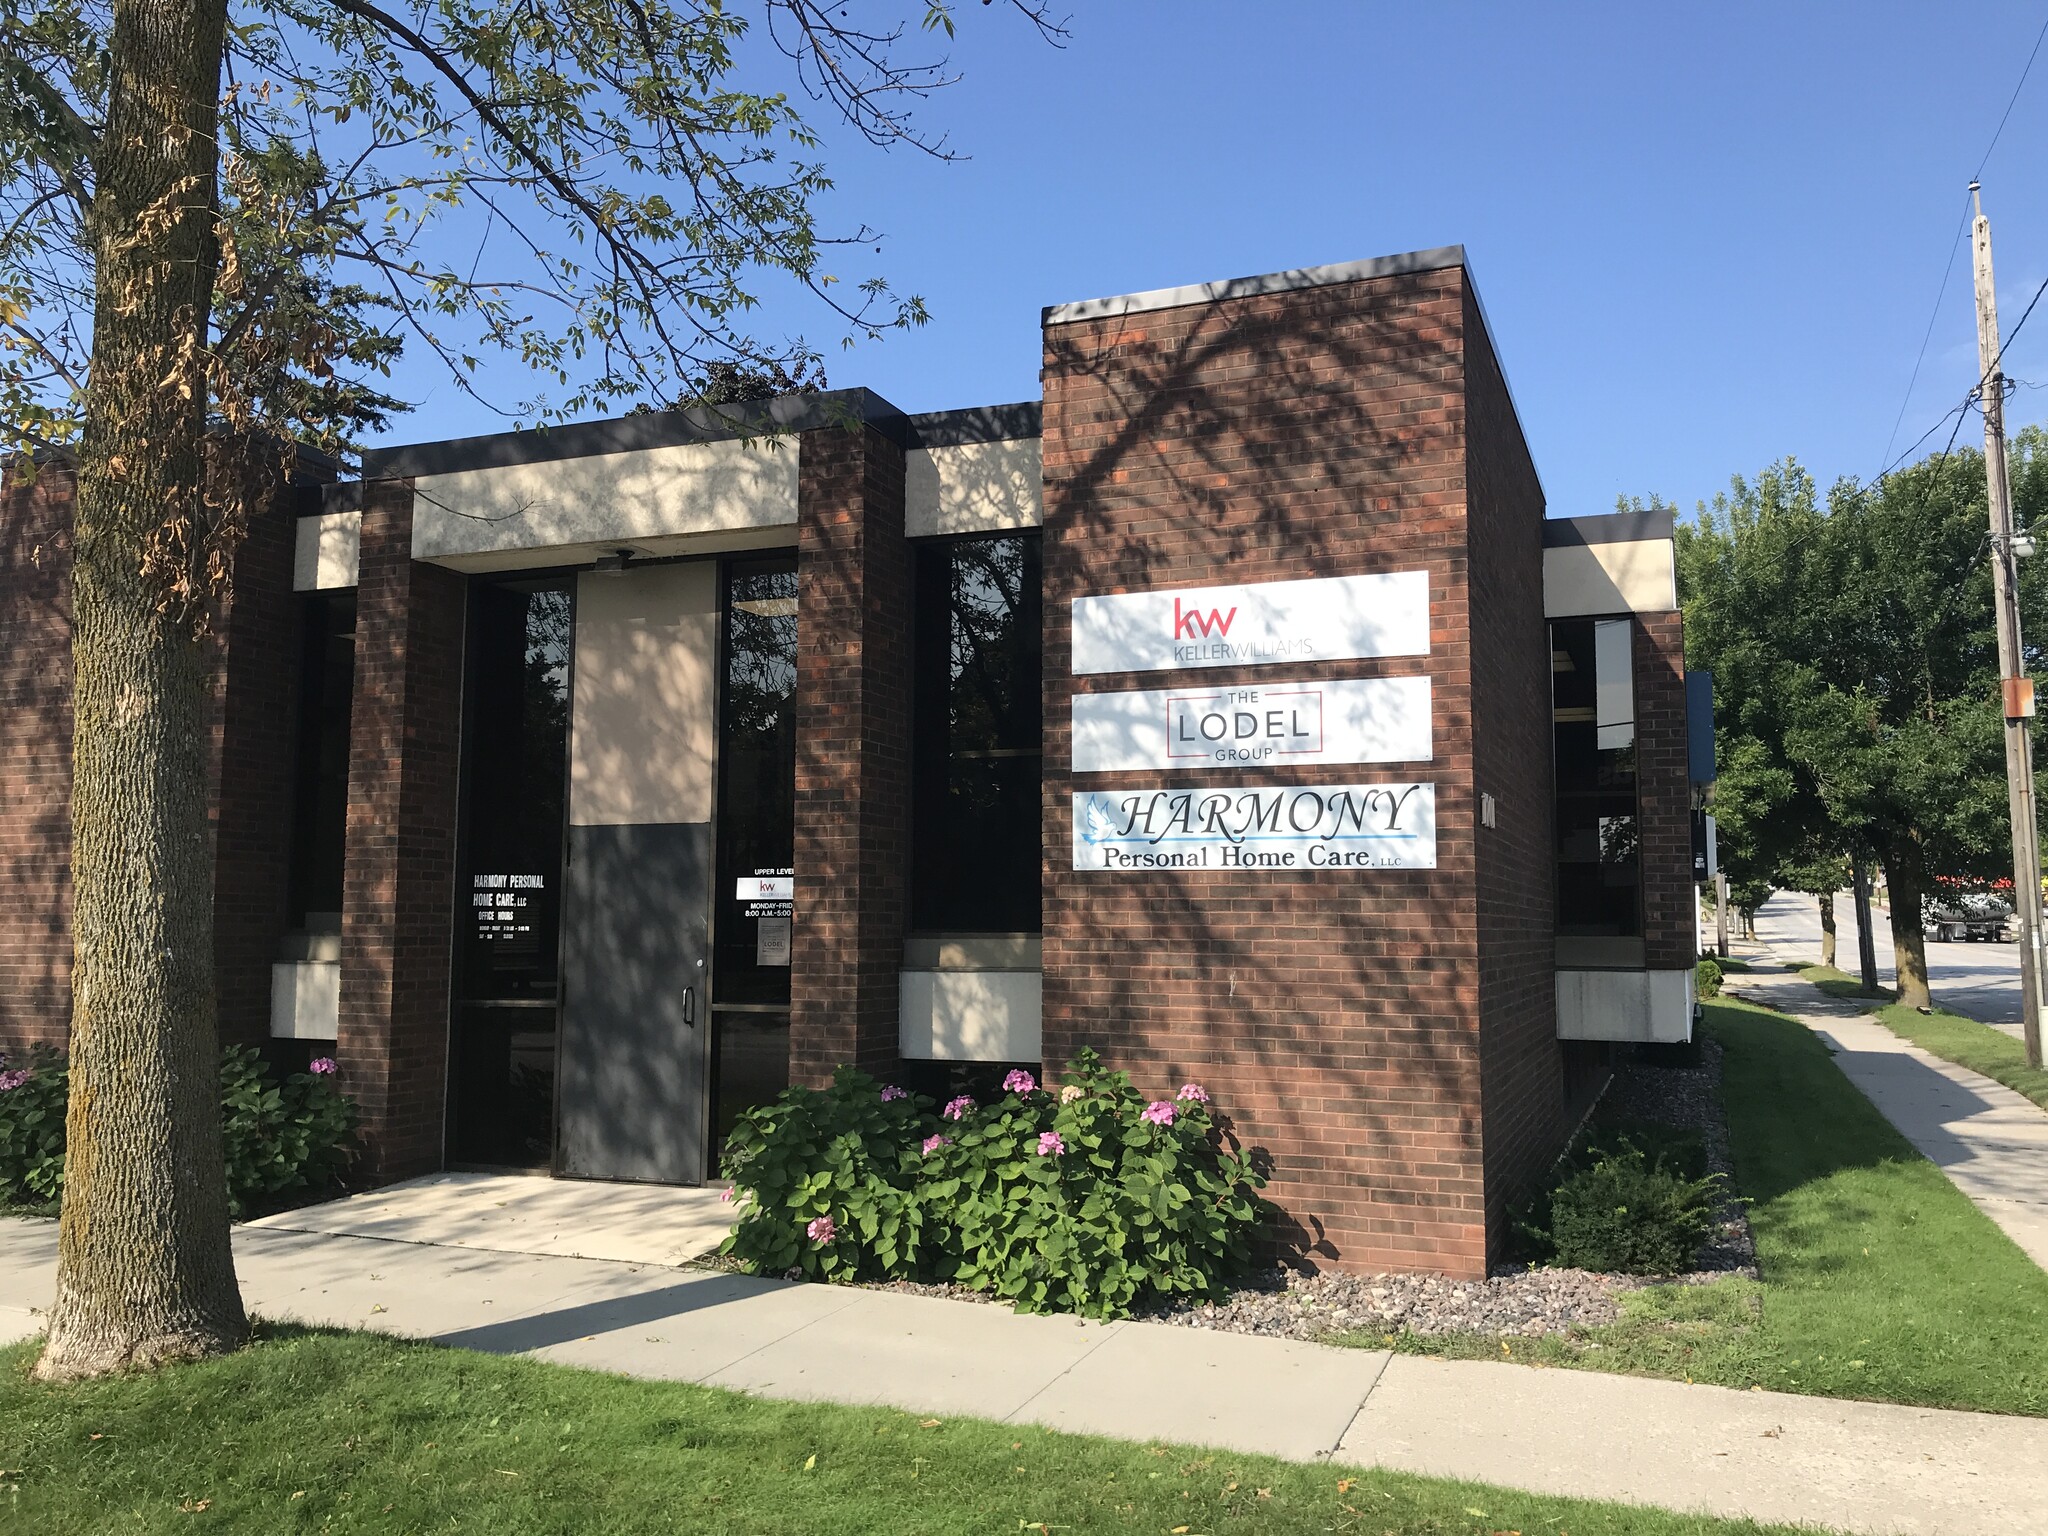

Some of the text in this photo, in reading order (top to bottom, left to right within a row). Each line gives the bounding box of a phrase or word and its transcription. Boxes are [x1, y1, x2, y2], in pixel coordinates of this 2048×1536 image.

[1174, 597, 1237, 641] kw
[1174, 638, 1313, 662] KELLERWILLIAMS
[1227, 691, 1259, 705] THE
[1179, 709, 1310, 742] LODEL
[1215, 747, 1273, 762] GROUP
[1117, 784, 1420, 845] HARMONY
[1102, 844, 1402, 868] Personal Home Care, LLC
[754, 868, 775, 876] UPPER
[474, 874, 544, 888] HARMONY PERSONAL
[760, 880, 775, 891] kw
[473, 893, 527, 907] HOME CARE, LLC
